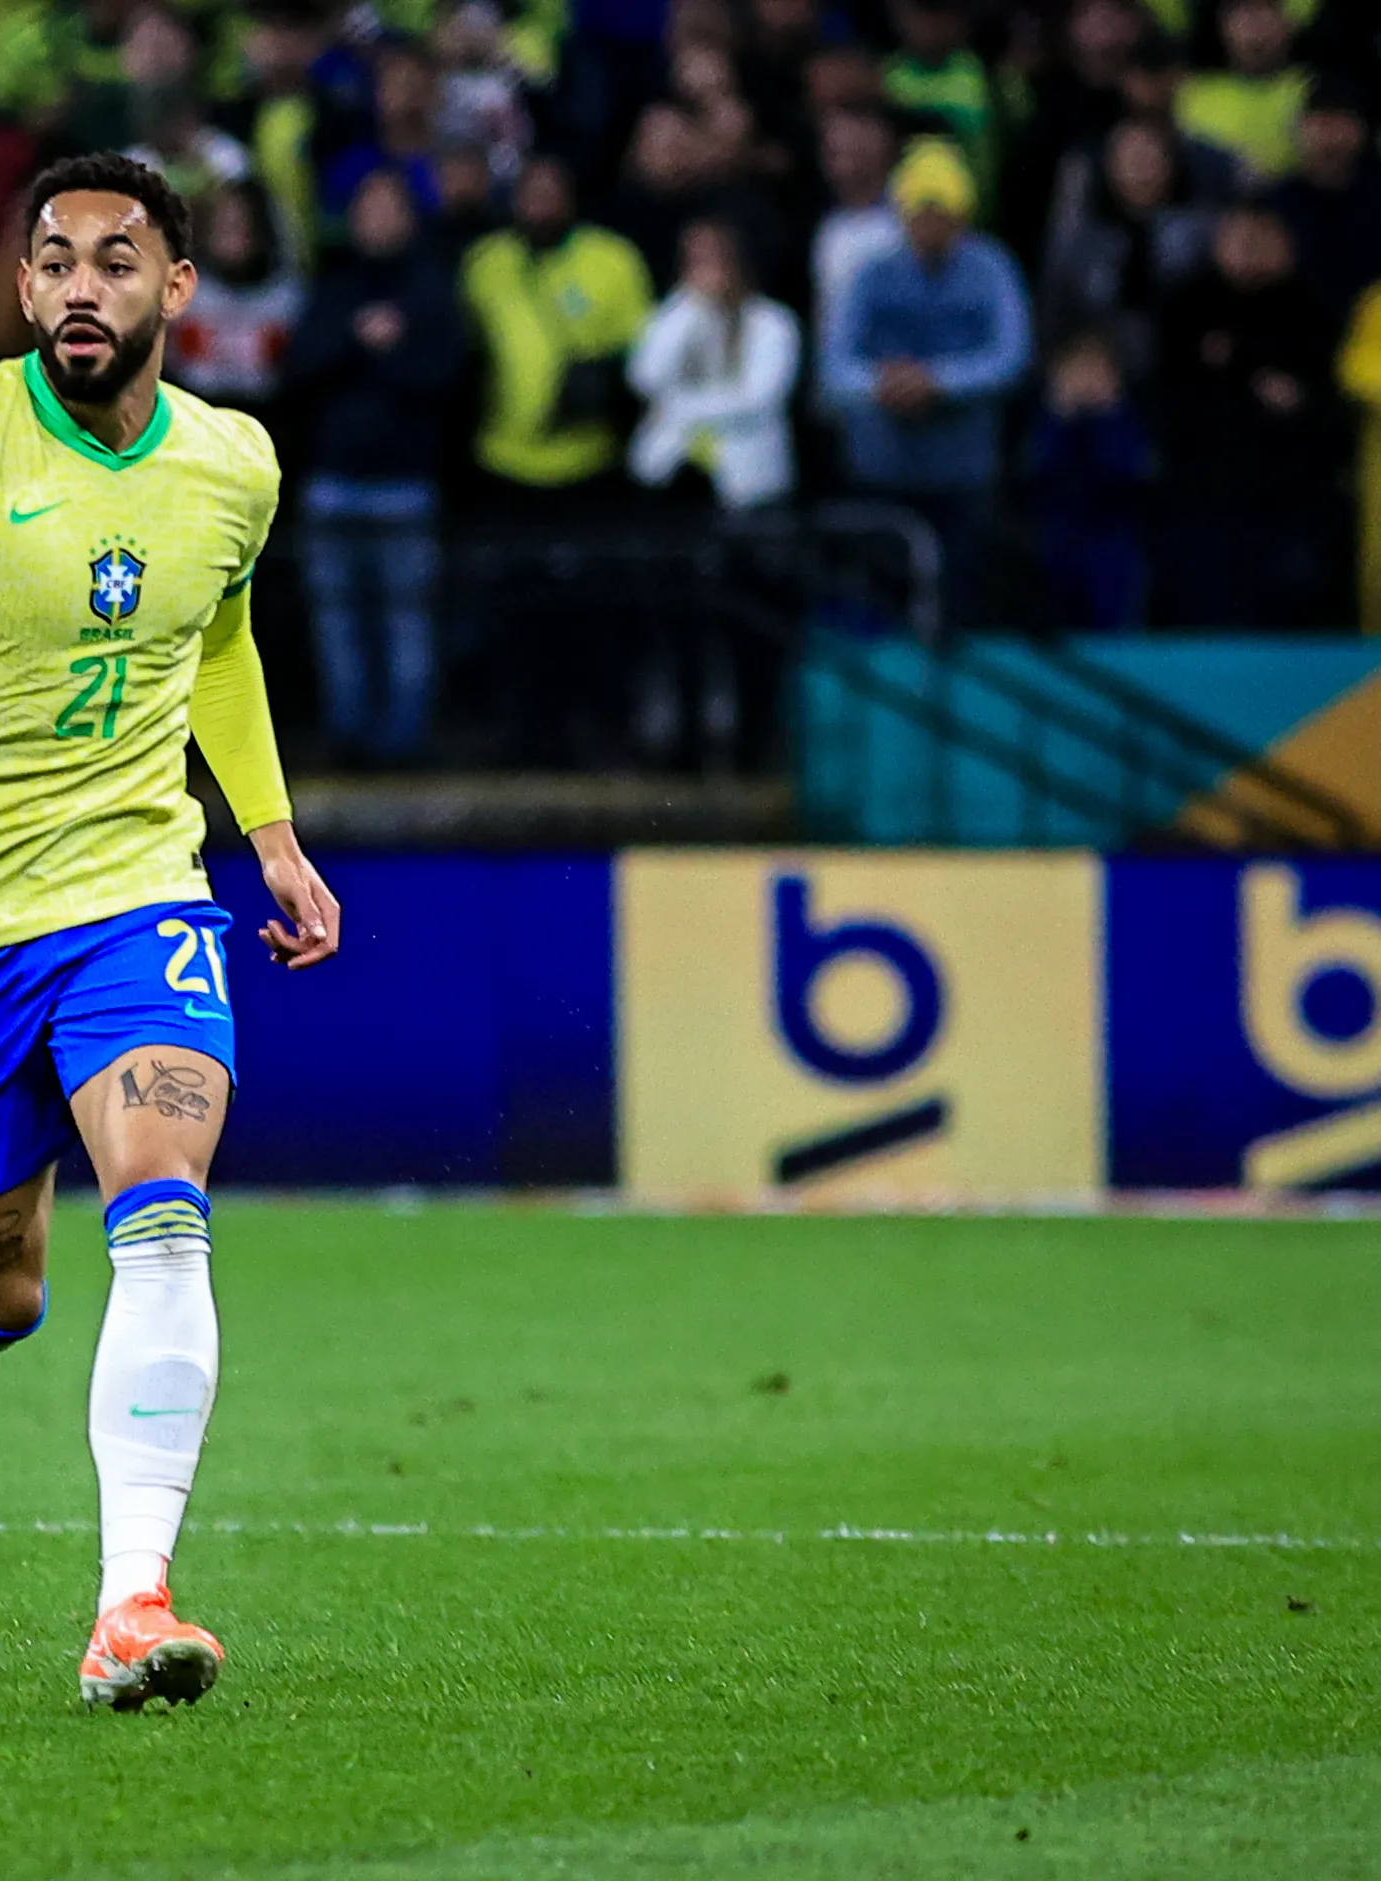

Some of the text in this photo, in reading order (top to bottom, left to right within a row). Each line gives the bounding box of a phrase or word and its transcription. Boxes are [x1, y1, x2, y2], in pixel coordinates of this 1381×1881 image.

[106, 579, 127, 589] CBF
[80, 627, 135, 641] BRASIL
[55, 655, 127, 739] 21
[156, 918, 228, 1005] 21
